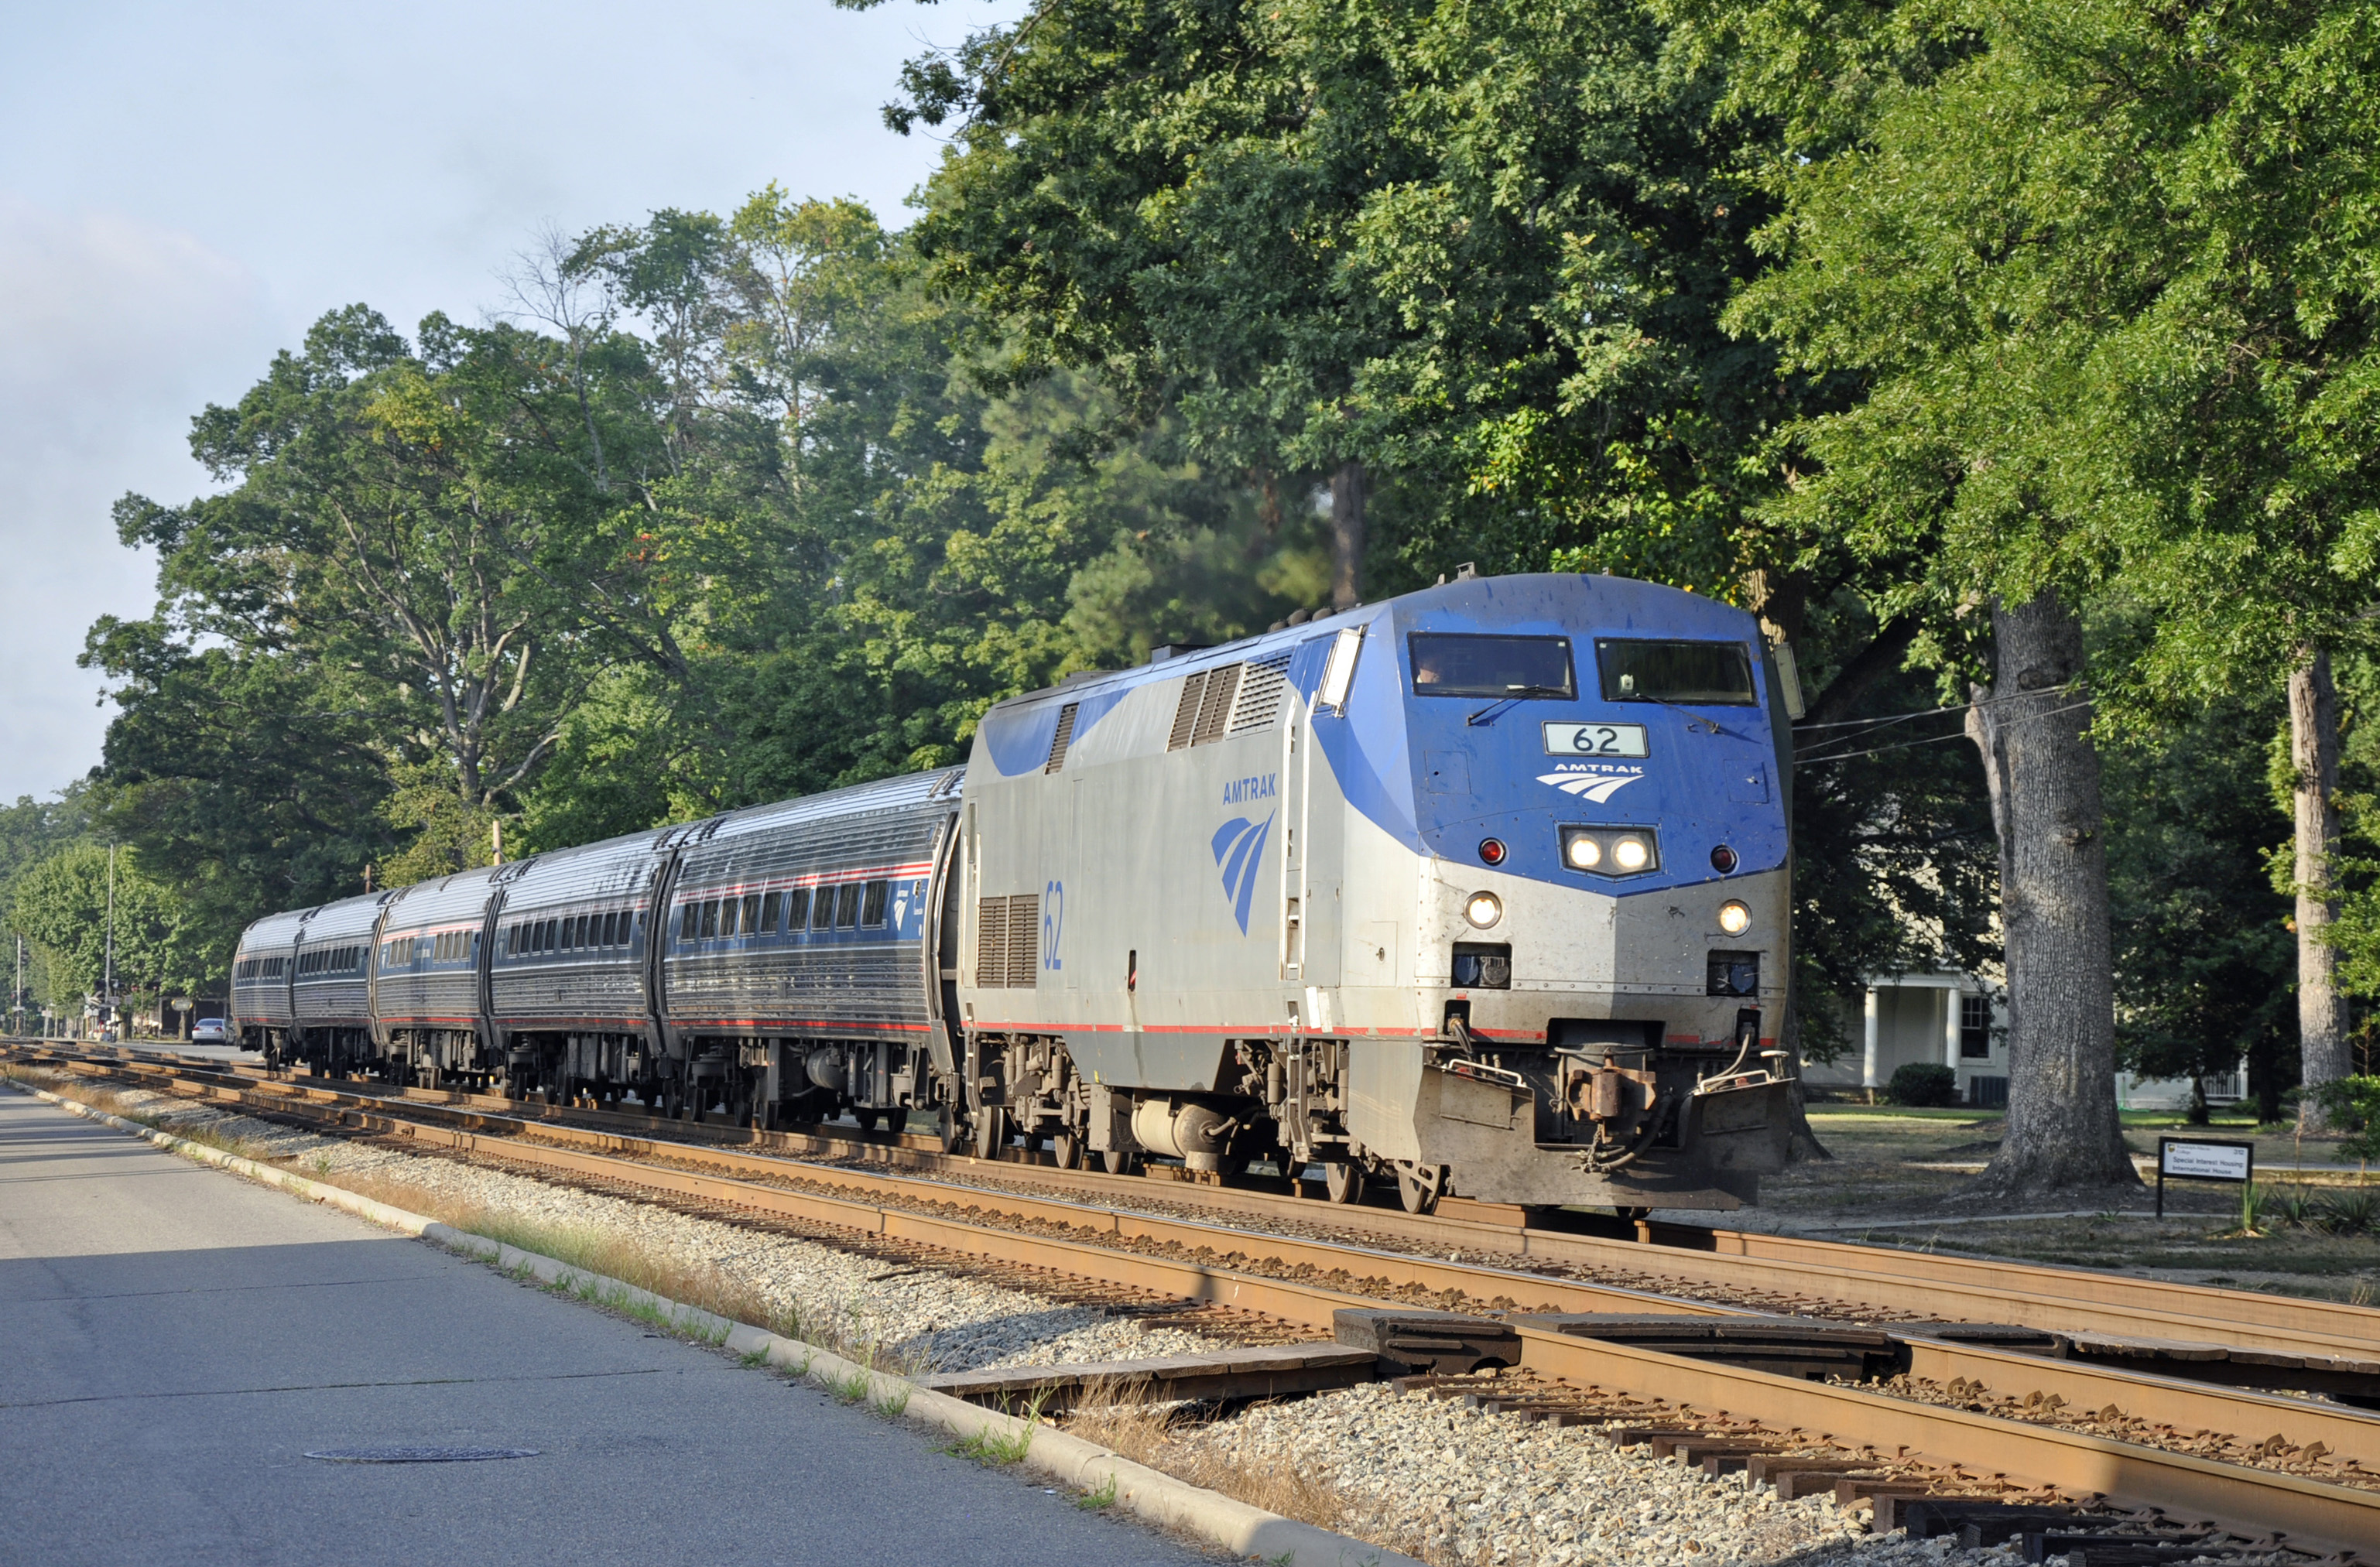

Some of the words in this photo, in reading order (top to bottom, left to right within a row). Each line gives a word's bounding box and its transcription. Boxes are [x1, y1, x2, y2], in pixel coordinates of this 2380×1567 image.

[1573, 727, 1620, 753] 62
[1554, 763, 1644, 774] AMTRAK
[1223, 772, 1276, 806] AMTRAK
[1044, 880, 1063, 970] 62
[2172, 1165, 2210, 1173] International
